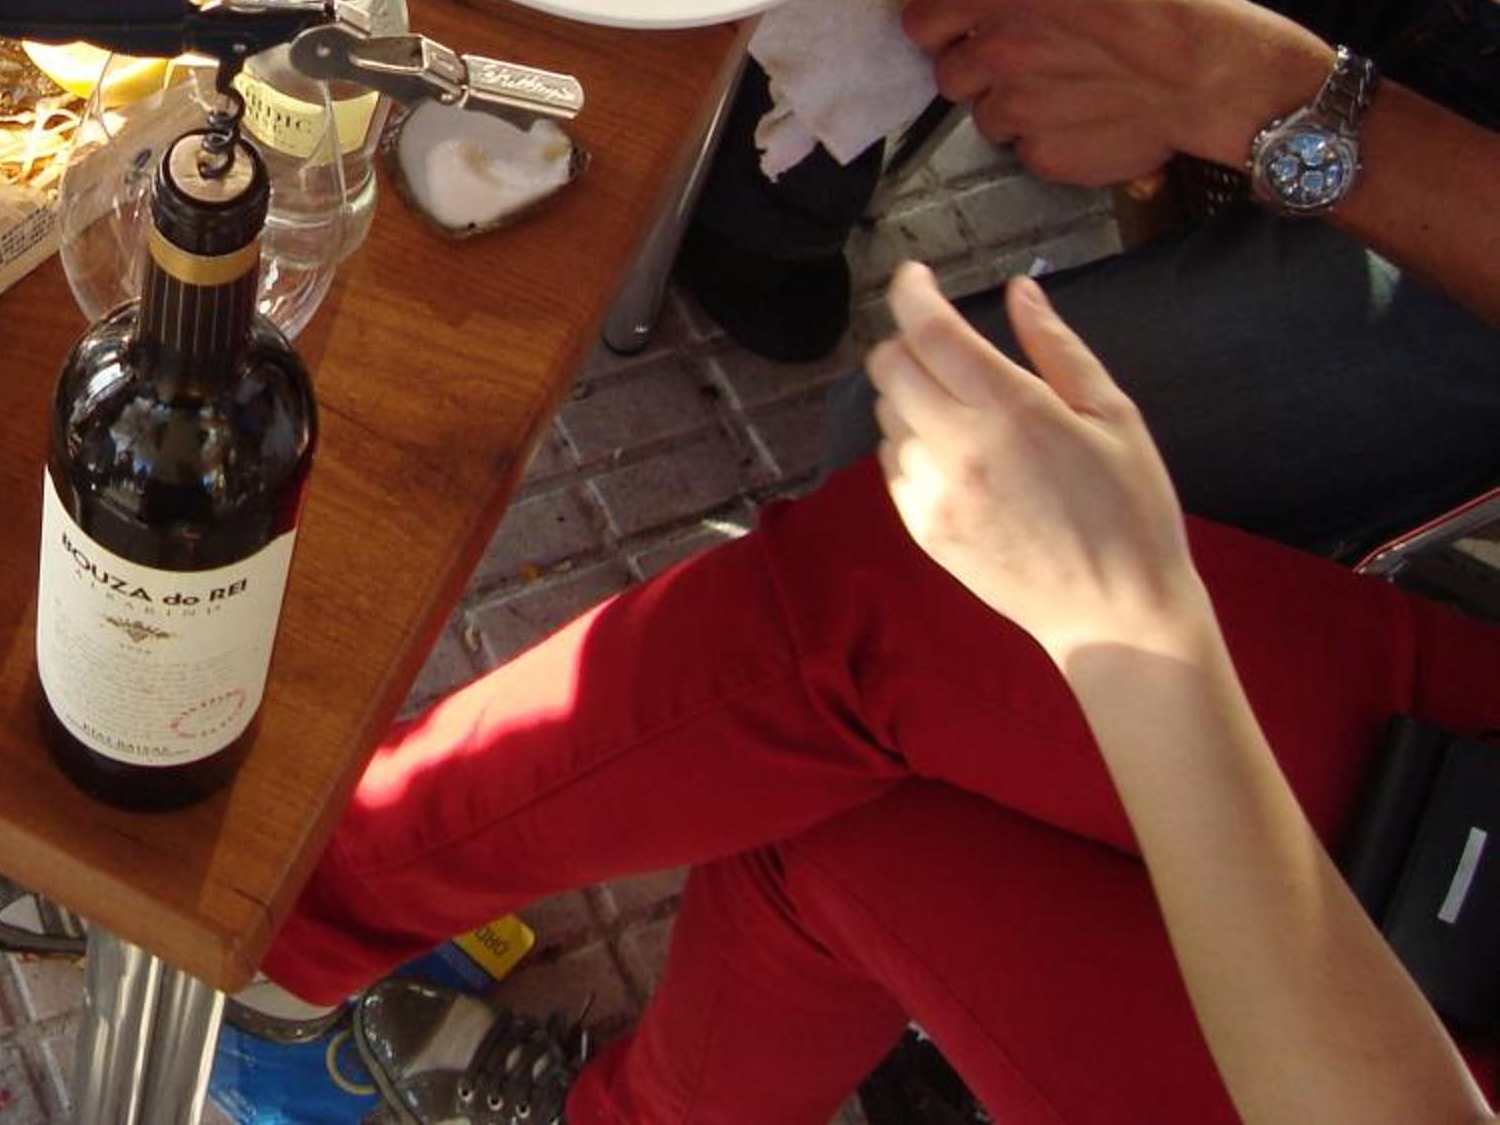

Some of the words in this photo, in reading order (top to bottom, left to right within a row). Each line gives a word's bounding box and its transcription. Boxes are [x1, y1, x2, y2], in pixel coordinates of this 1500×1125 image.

[61, 531, 153, 603] BOUZA
[162, 591, 201, 606] do
[208, 577, 248, 603] REI
